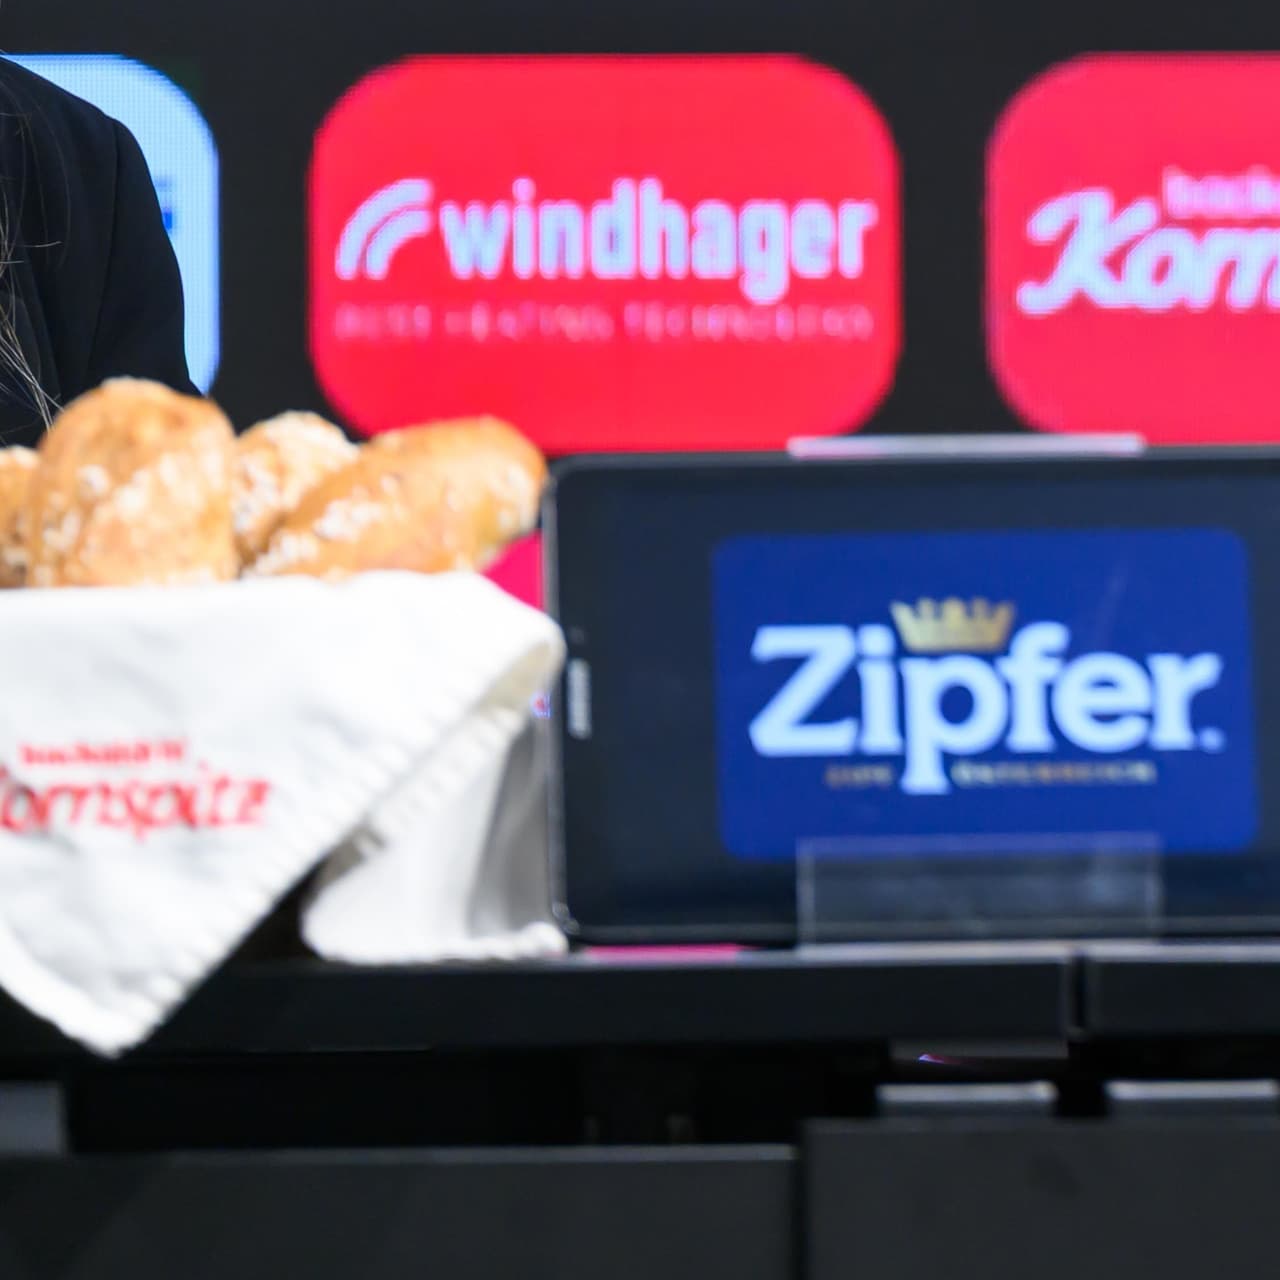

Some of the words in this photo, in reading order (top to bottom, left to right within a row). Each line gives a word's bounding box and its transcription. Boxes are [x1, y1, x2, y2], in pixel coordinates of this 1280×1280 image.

[440, 180, 876, 305] windhager
[749, 620, 1222, 795] Zipfer
[0, 760, 270, 842] ornspitz
